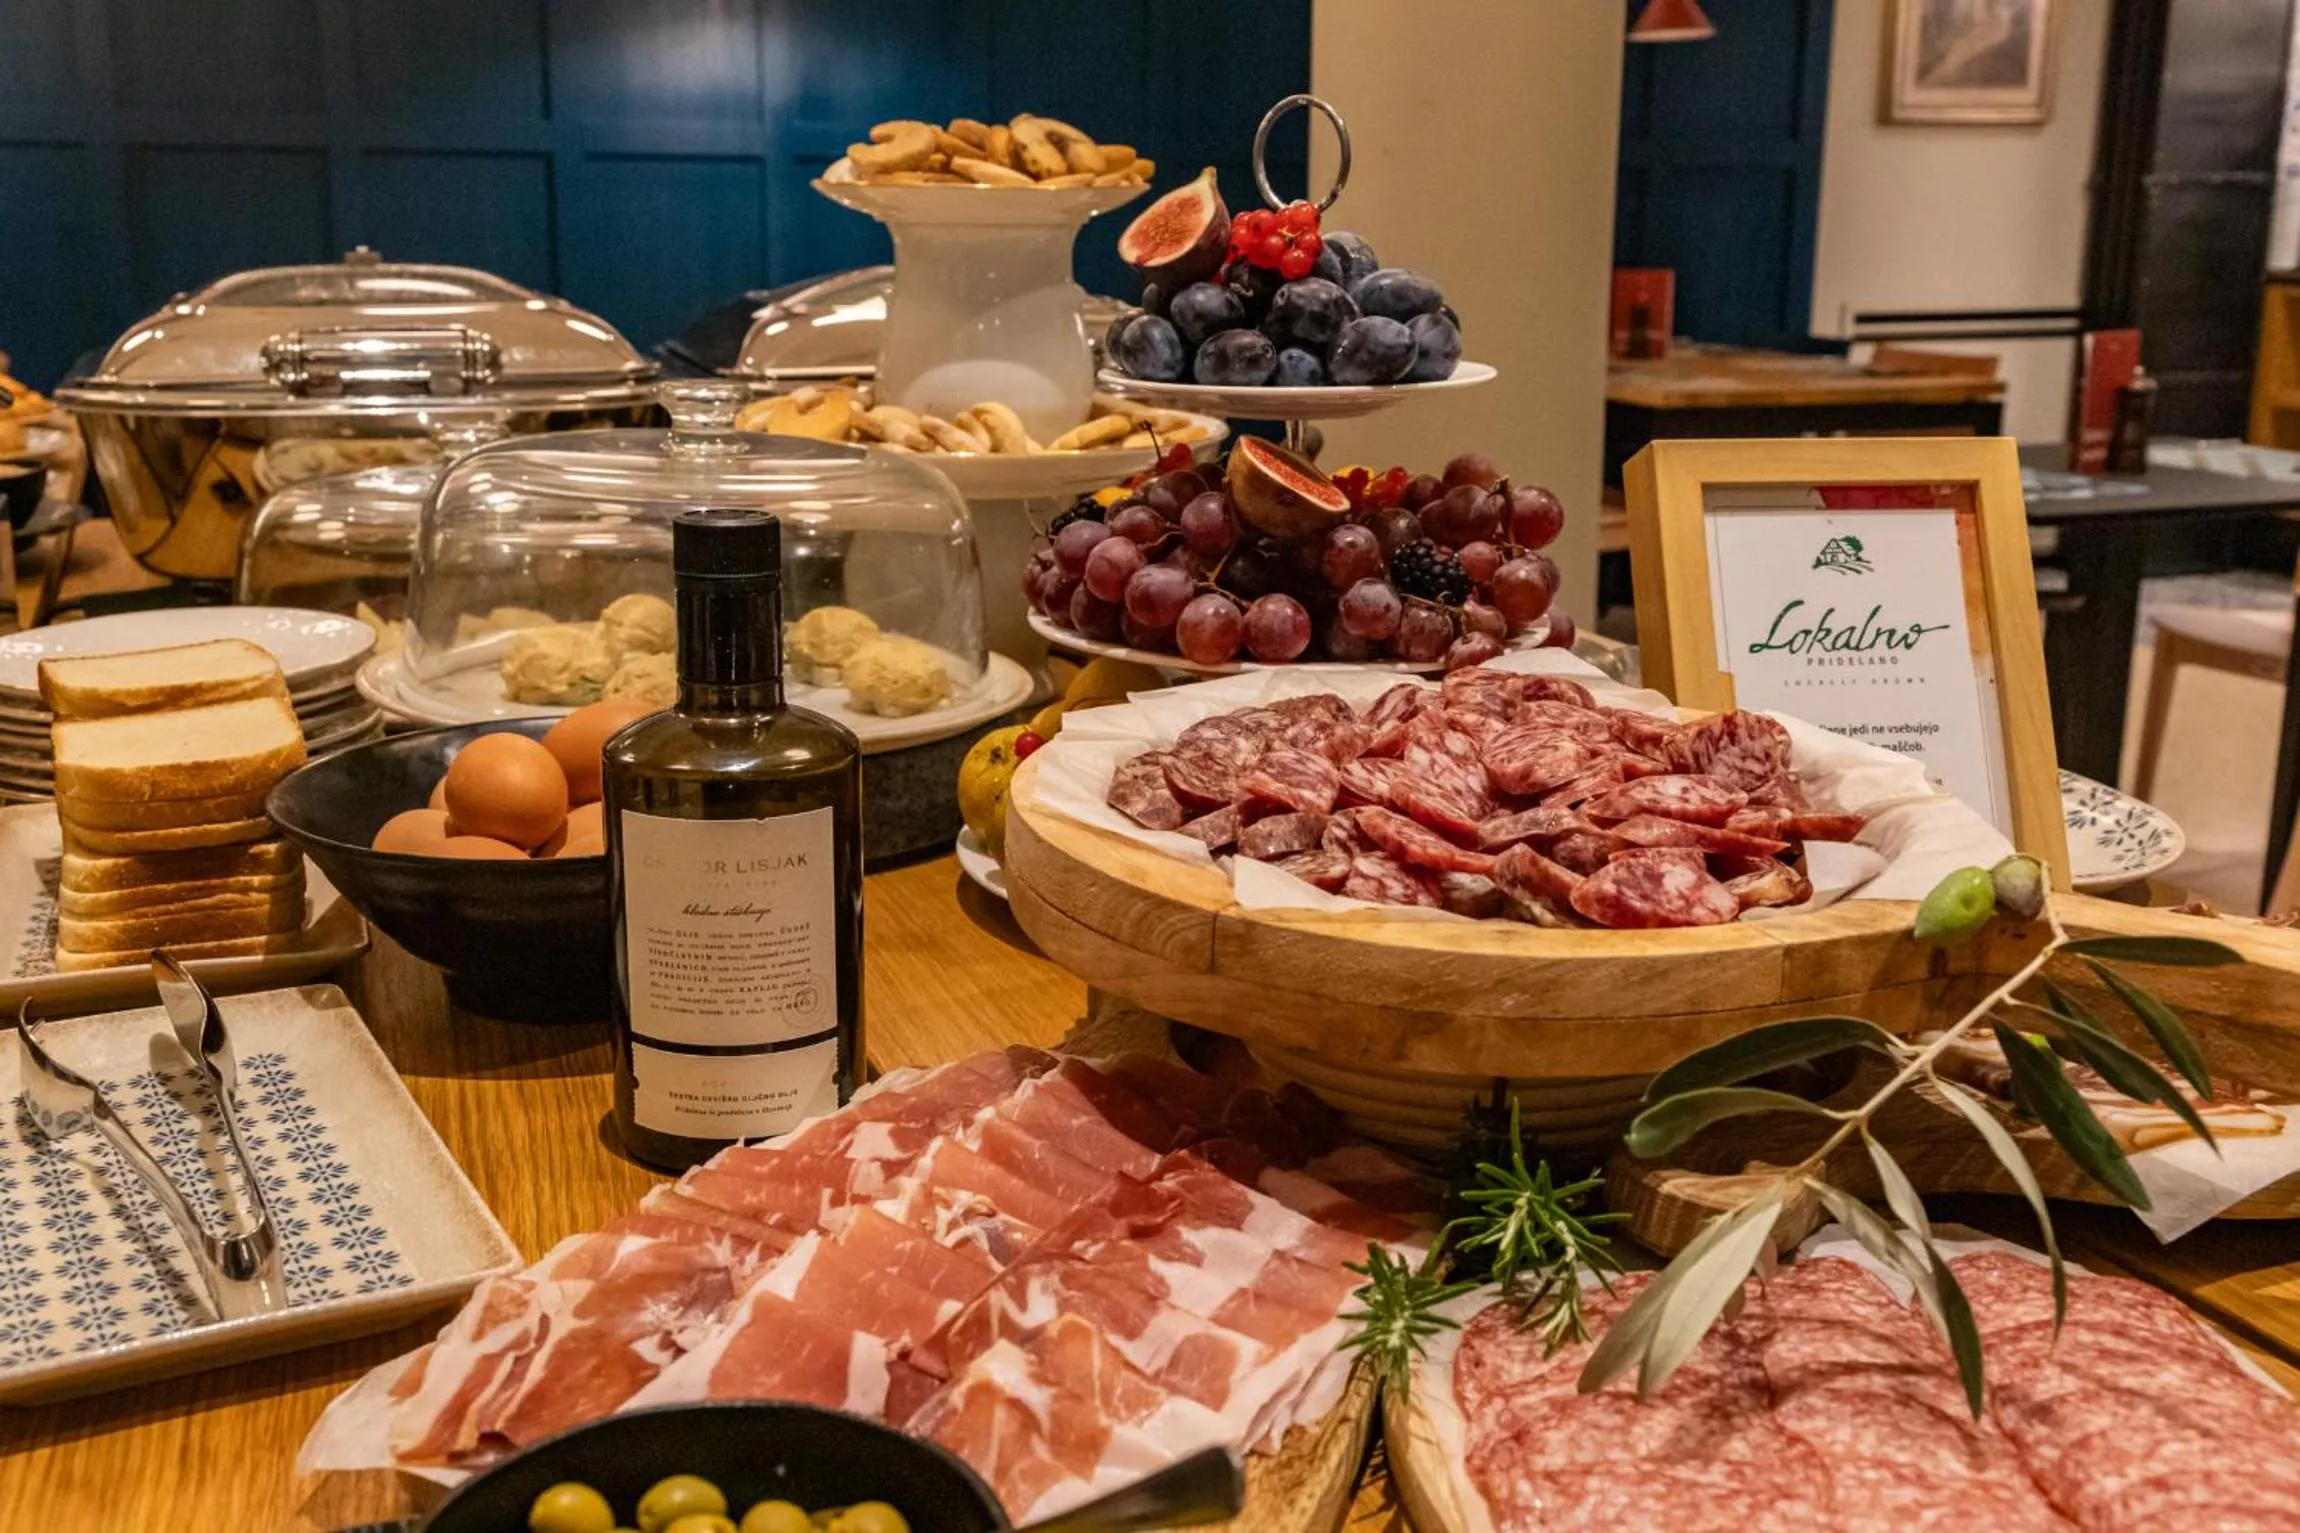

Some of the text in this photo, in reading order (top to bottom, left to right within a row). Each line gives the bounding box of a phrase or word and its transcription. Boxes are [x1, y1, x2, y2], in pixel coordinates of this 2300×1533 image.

[1748, 599, 1950, 654] Lokalno
[1806, 656, 1899, 666] PRIDELANO
[1848, 723, 1869, 737] jedi
[1872, 725, 1885, 734] ne
[1887, 722, 1939, 735] vsebujejo
[736, 852, 808, 873] LISJAK
